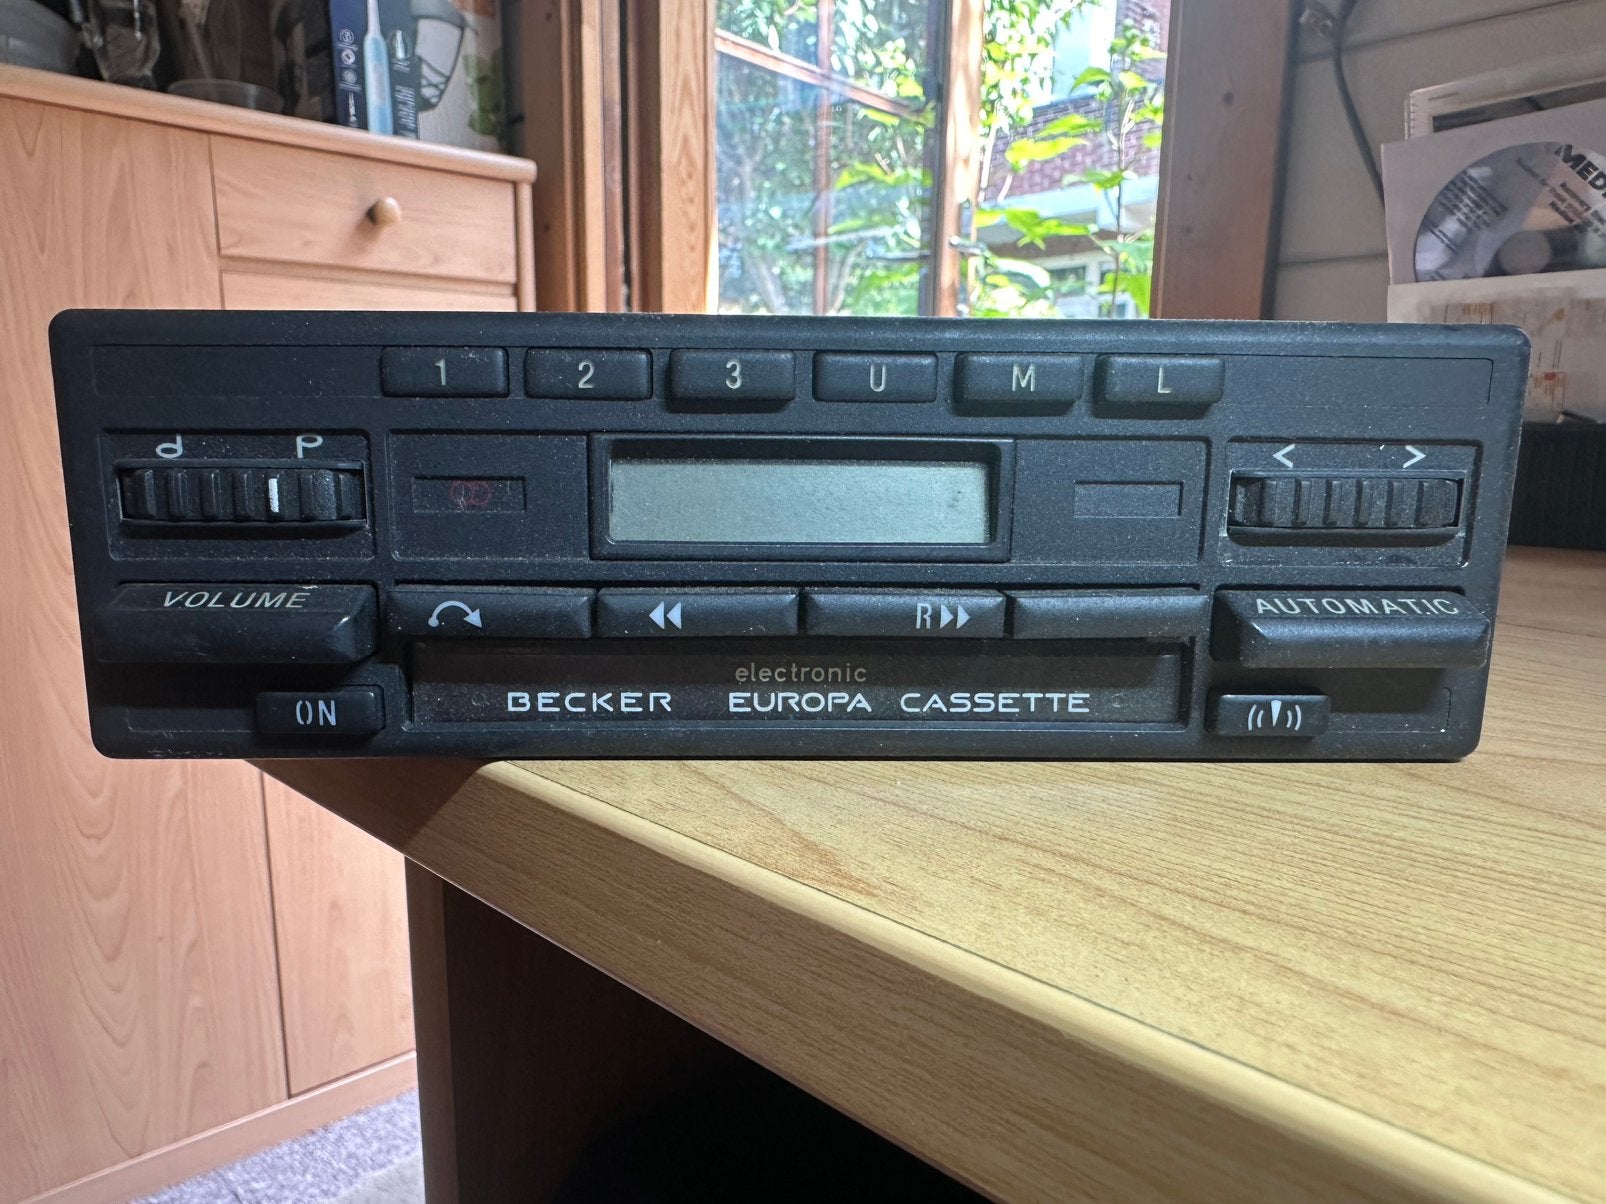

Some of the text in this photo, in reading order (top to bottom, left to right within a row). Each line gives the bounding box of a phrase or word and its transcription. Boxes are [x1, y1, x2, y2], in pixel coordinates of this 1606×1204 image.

[1554, 144, 1606, 199] MED
[435, 358, 446, 385] 1
[577, 360, 594, 388] 2
[725, 361, 742, 389] 3
[870, 364, 887, 392] U
[1012, 364, 1036, 391] M
[1156, 367, 1172, 393] L
[163, 591, 311, 608] VOLUME
[1255, 598, 1460, 615] AUTOMATIC
[916, 603, 931, 629] R
[735, 662, 867, 683] electronic
[295, 700, 337, 726] ON
[507, 692, 1090, 713] BECKER EUROPA CASSETTE
